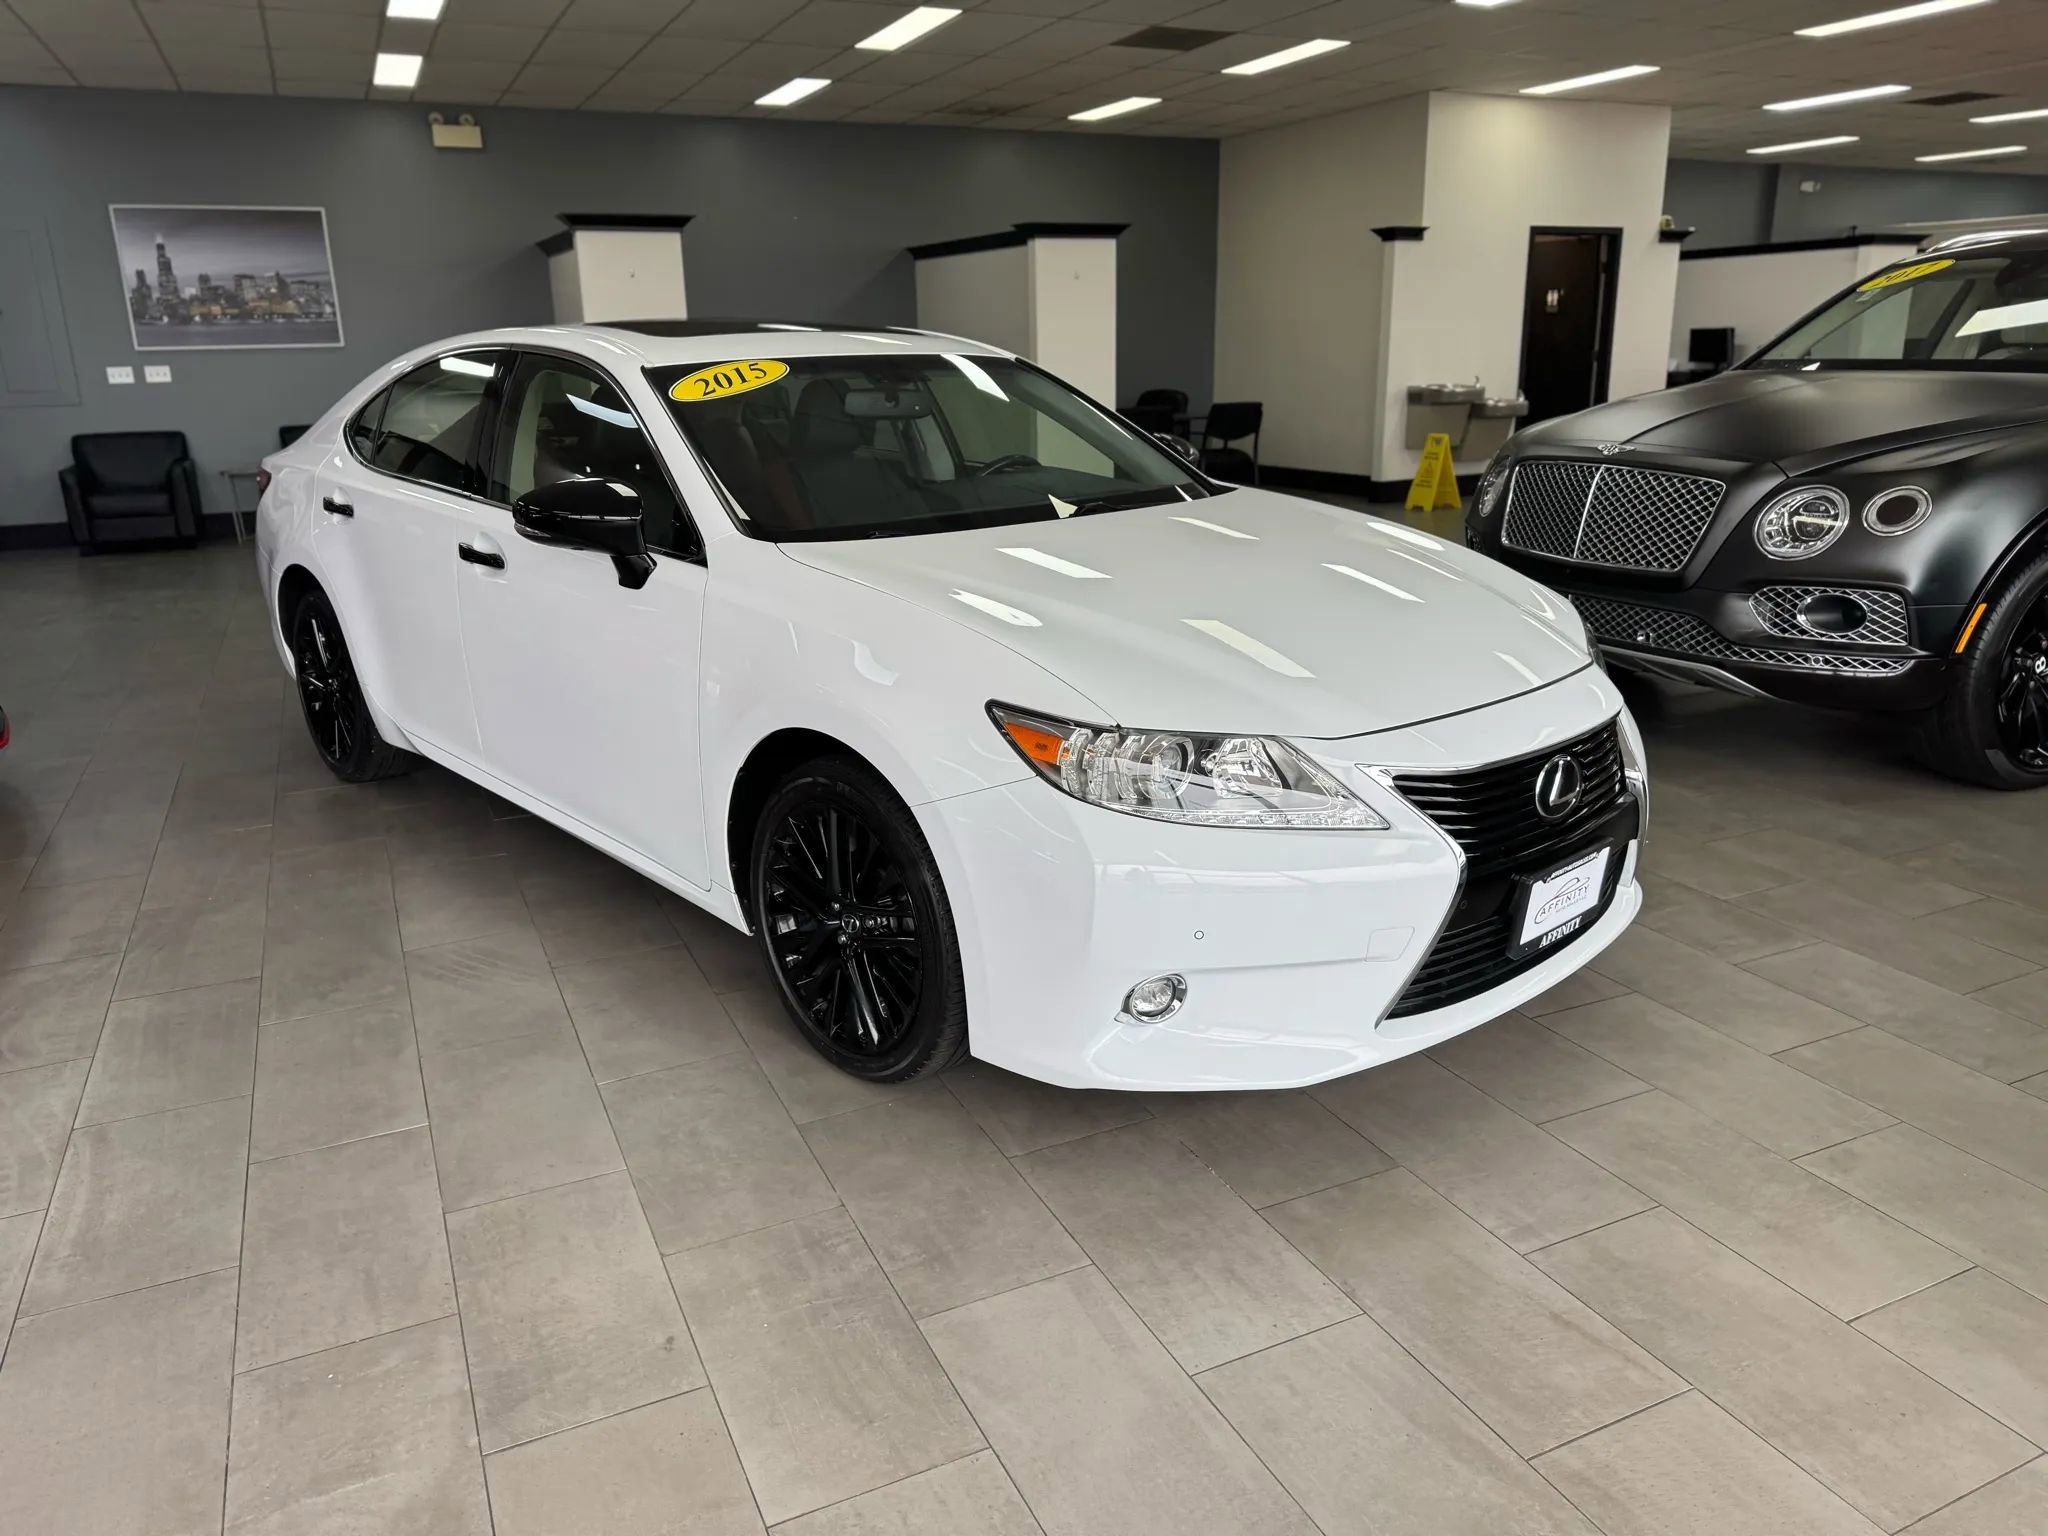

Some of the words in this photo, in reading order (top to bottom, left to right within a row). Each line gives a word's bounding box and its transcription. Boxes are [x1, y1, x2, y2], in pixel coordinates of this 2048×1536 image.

[694, 362, 767, 396] 2015
[1539, 884, 1590, 917] AFFINITY
[1538, 916, 1583, 949] AFFINITY
